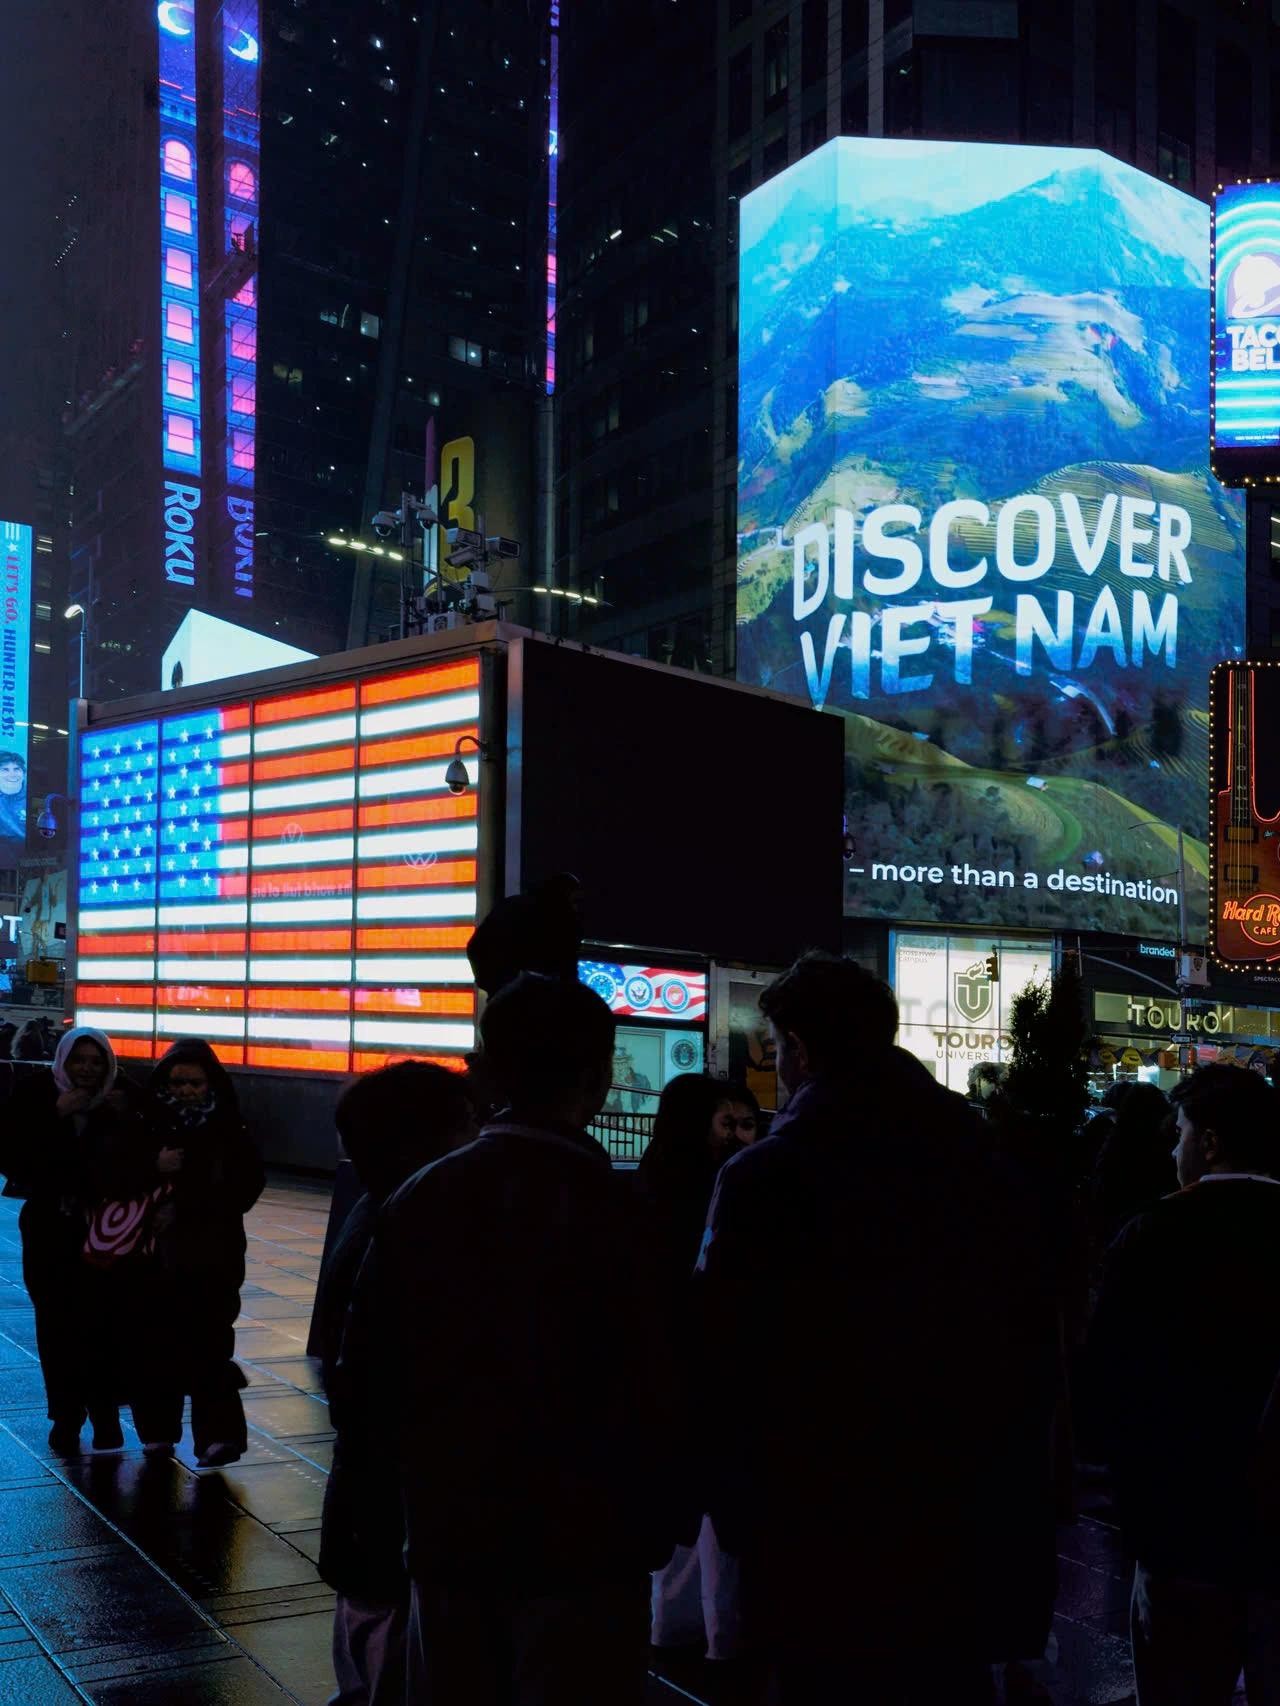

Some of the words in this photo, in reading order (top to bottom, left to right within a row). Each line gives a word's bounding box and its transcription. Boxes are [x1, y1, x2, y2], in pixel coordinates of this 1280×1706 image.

[793, 492, 1193, 620] DISCOVER
[5, 555, 19, 593] LET'S
[2, 628, 17, 692] HUNTER
[800, 597, 993, 712] VIET
[1015, 584, 1179, 676] NAM
[871, 863, 944, 884] more
[951, 864, 1015, 888] than
[1023, 873, 1038, 889] a
[1047, 868, 1178, 905] destination
[1222, 899, 1267, 921] Hard
[1253, 925, 1277, 936] CAFE
[1140, 944, 1176, 958] branded
[1131, 1004, 1219, 1034] TOURO
[933, 1032, 1014, 1050] TOURO
